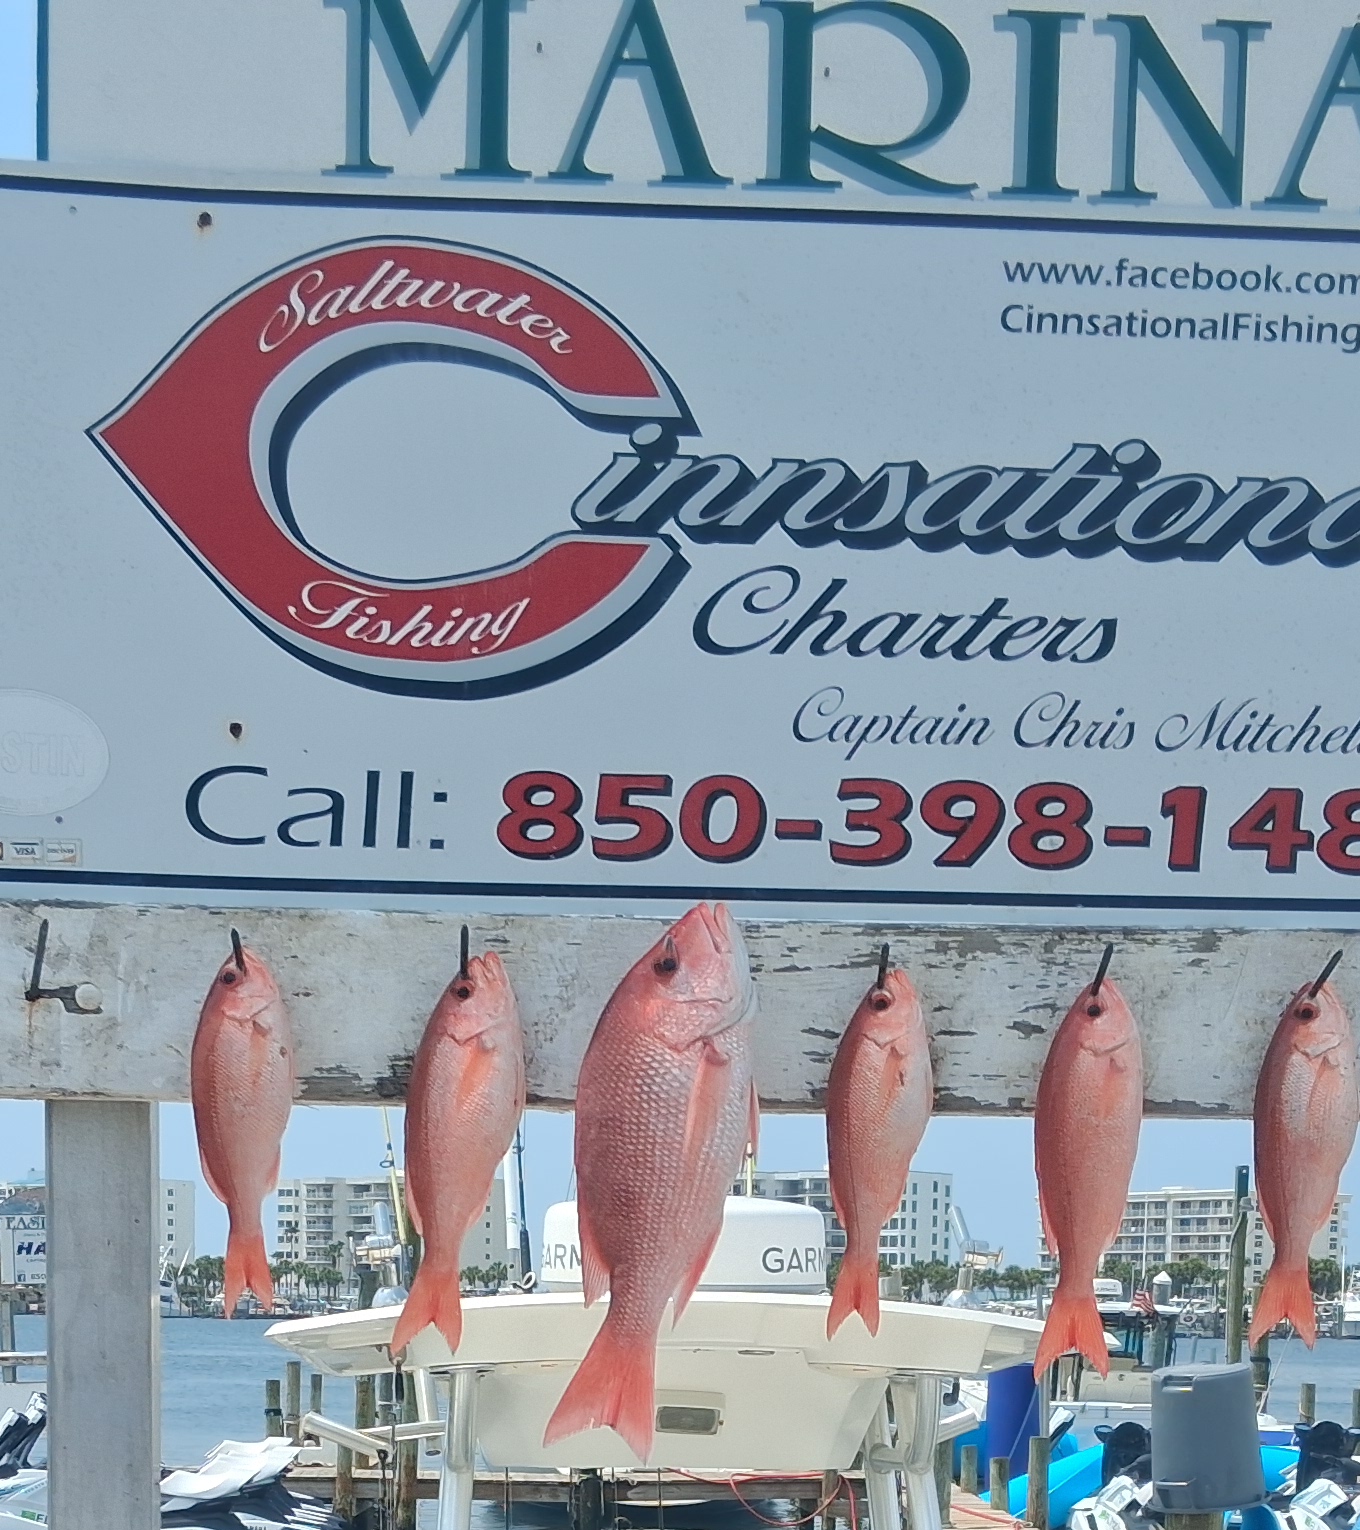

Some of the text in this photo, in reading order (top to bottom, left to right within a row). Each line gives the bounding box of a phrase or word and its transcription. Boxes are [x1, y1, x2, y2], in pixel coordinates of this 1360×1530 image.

[259, 259, 574, 355] Saltwater
[288, 580, 531, 655] Fishing
[691, 564, 1120, 666] Charters
[792, 686, 995, 760] Captain
[1013, 691, 1136, 752] Chris
[185, 766, 447, 851] Call:
[16, 1242, 46, 1255] HA
